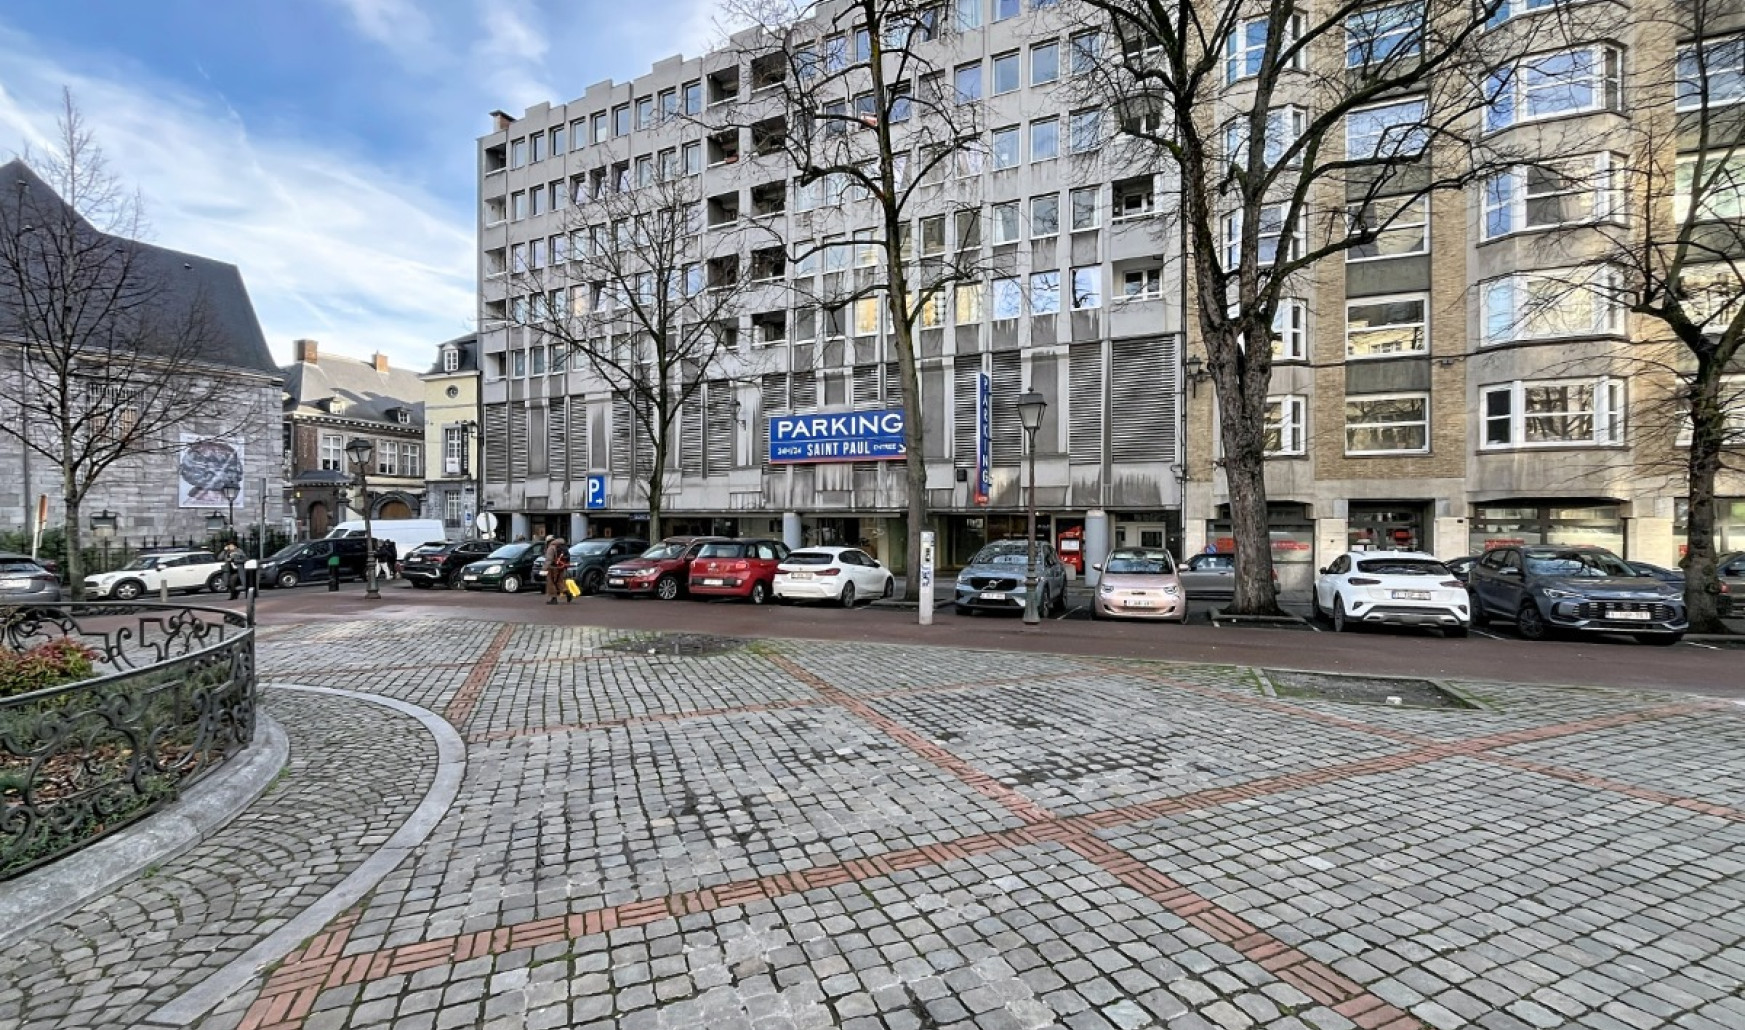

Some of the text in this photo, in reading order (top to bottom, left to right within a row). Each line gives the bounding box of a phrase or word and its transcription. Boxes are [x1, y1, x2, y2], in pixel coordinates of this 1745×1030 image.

[778, 413, 903, 439] PARKING
[807, 442, 839, 456] SAINT
[843, 441, 870, 455] PAUL
[588, 478, 600, 503] P
